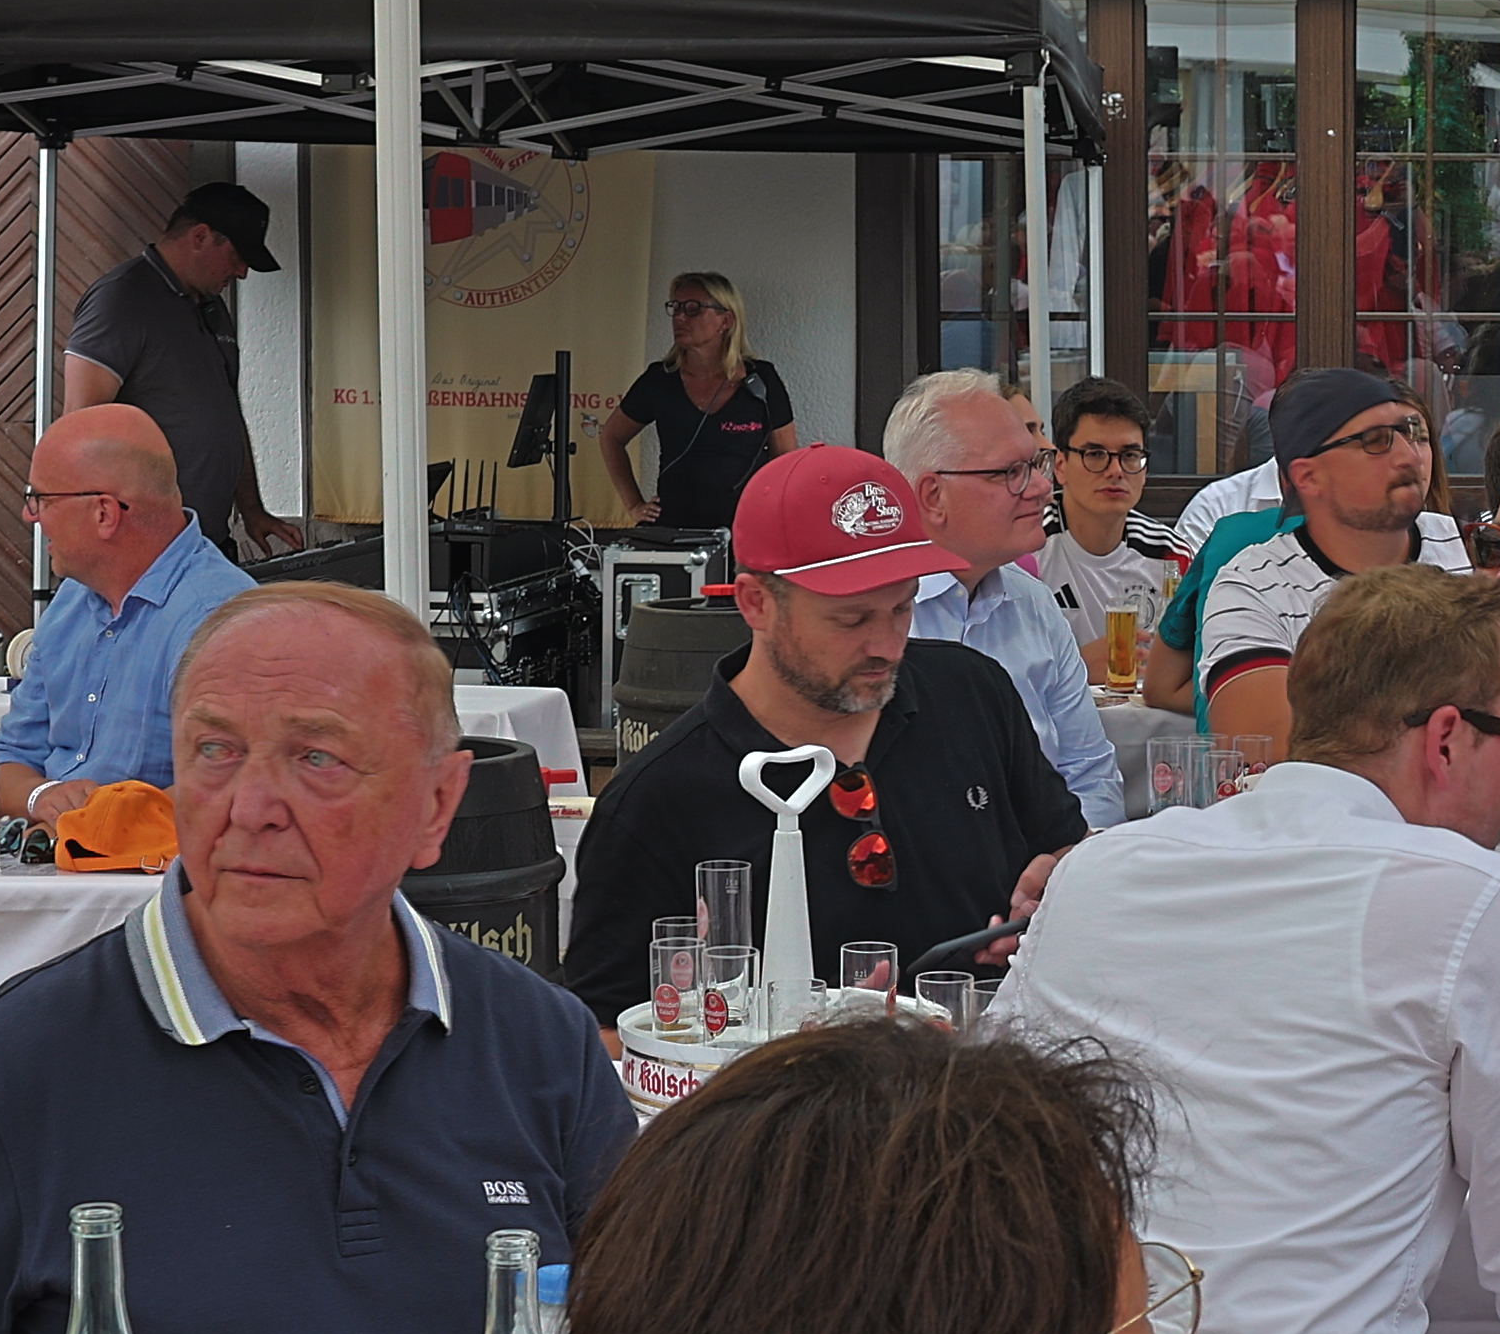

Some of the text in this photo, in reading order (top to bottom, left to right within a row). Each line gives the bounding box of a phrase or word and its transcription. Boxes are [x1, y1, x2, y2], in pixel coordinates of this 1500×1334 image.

[464, 248, 572, 307] AUTHENTISCH
[333, 388, 358, 405] KG
[362, 389, 375, 405] 1.
[482, 1180, 528, 1196] BOSS
